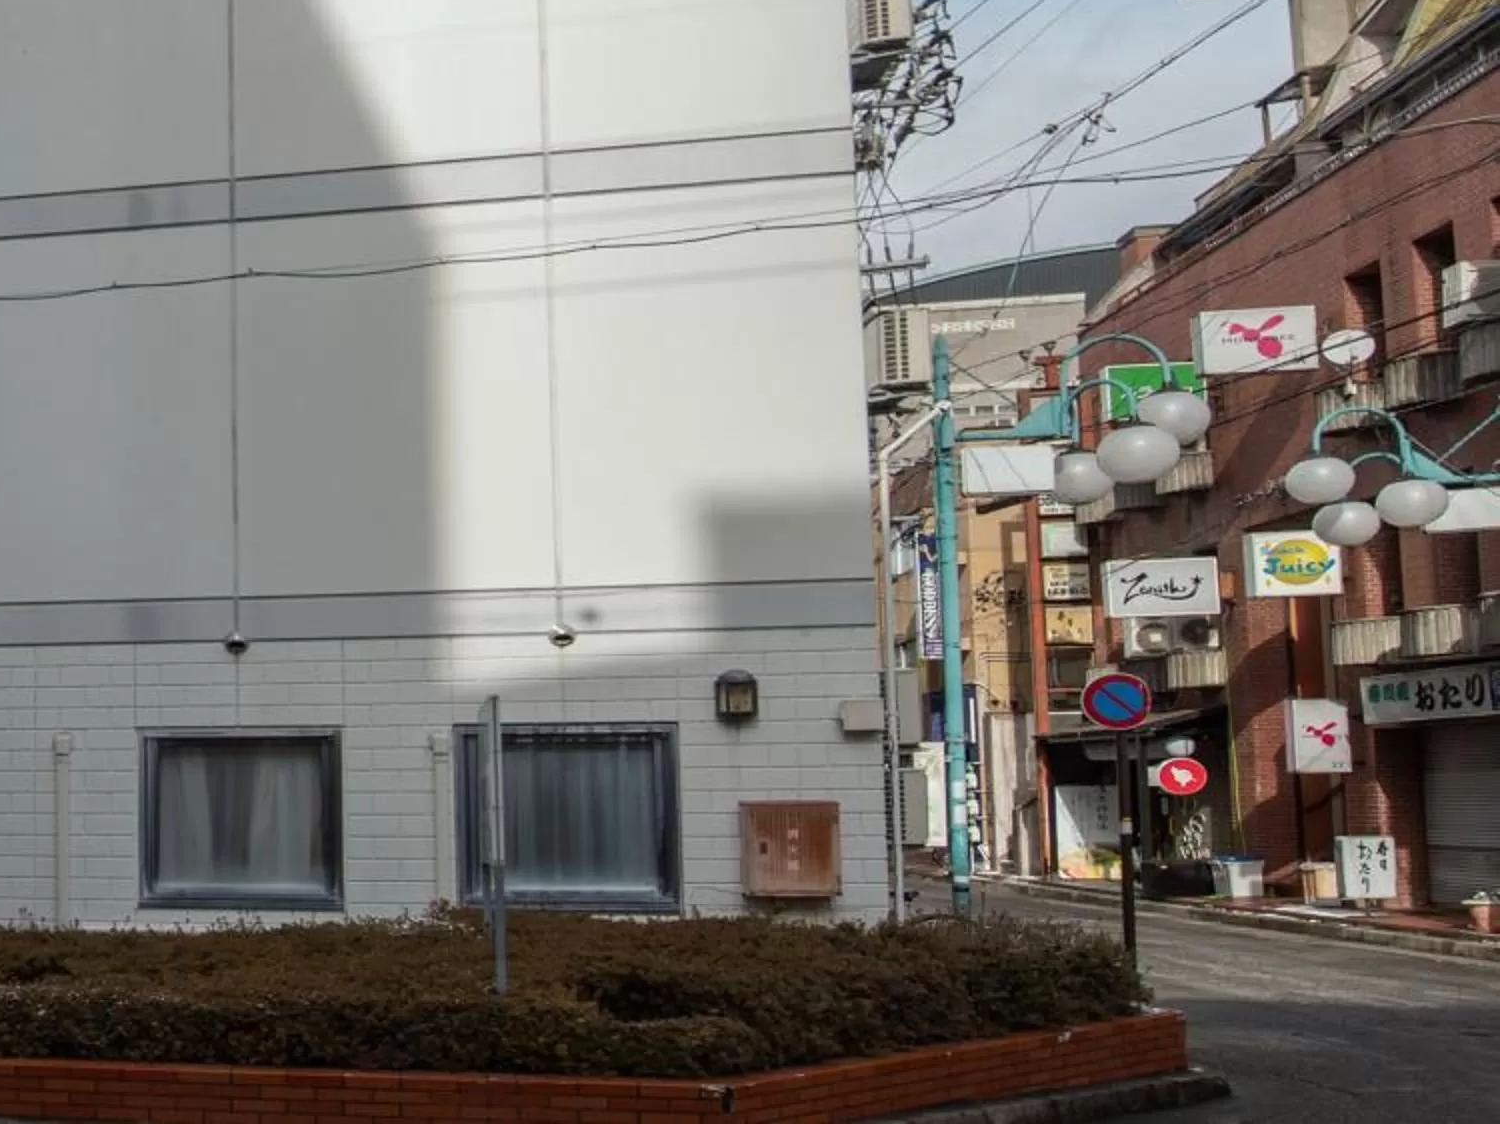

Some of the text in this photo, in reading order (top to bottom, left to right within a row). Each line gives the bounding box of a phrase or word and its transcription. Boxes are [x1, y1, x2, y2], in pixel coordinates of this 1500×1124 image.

[1263, 556, 1336, 574] Juicy
[1414, 673, 1486, 712] おたり
